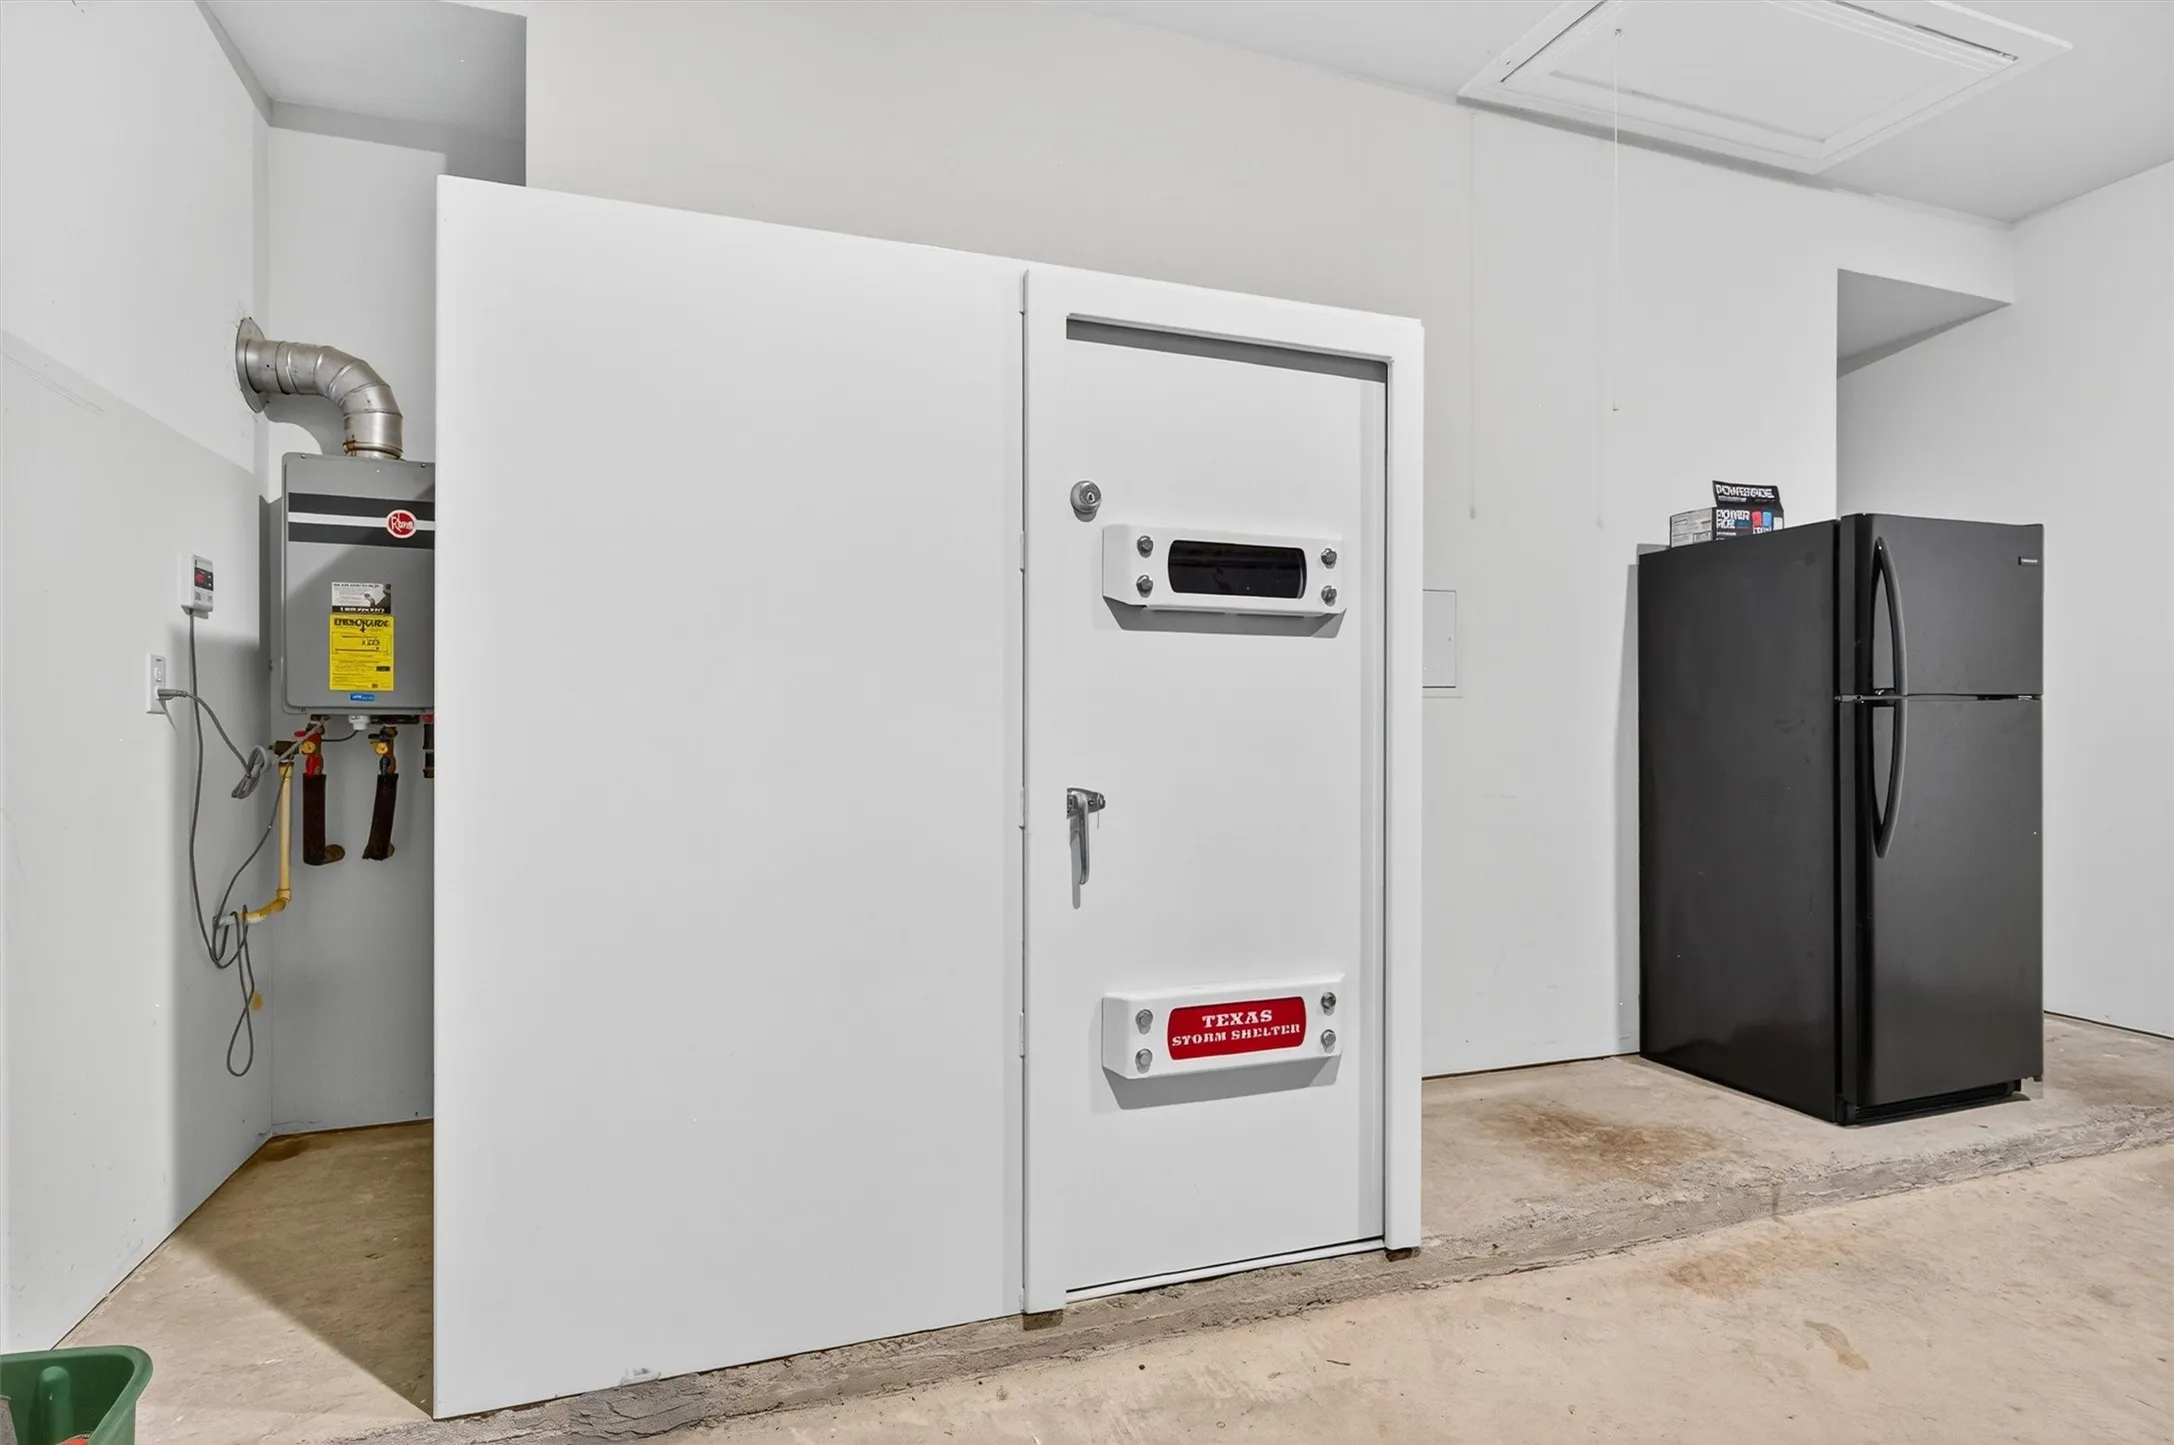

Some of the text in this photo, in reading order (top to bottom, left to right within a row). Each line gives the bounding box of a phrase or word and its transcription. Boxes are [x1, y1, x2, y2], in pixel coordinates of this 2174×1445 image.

[1202, 1009, 1273, 1028] TEXAS
[1171, 1023, 1301, 1047] STORM SHELTER
